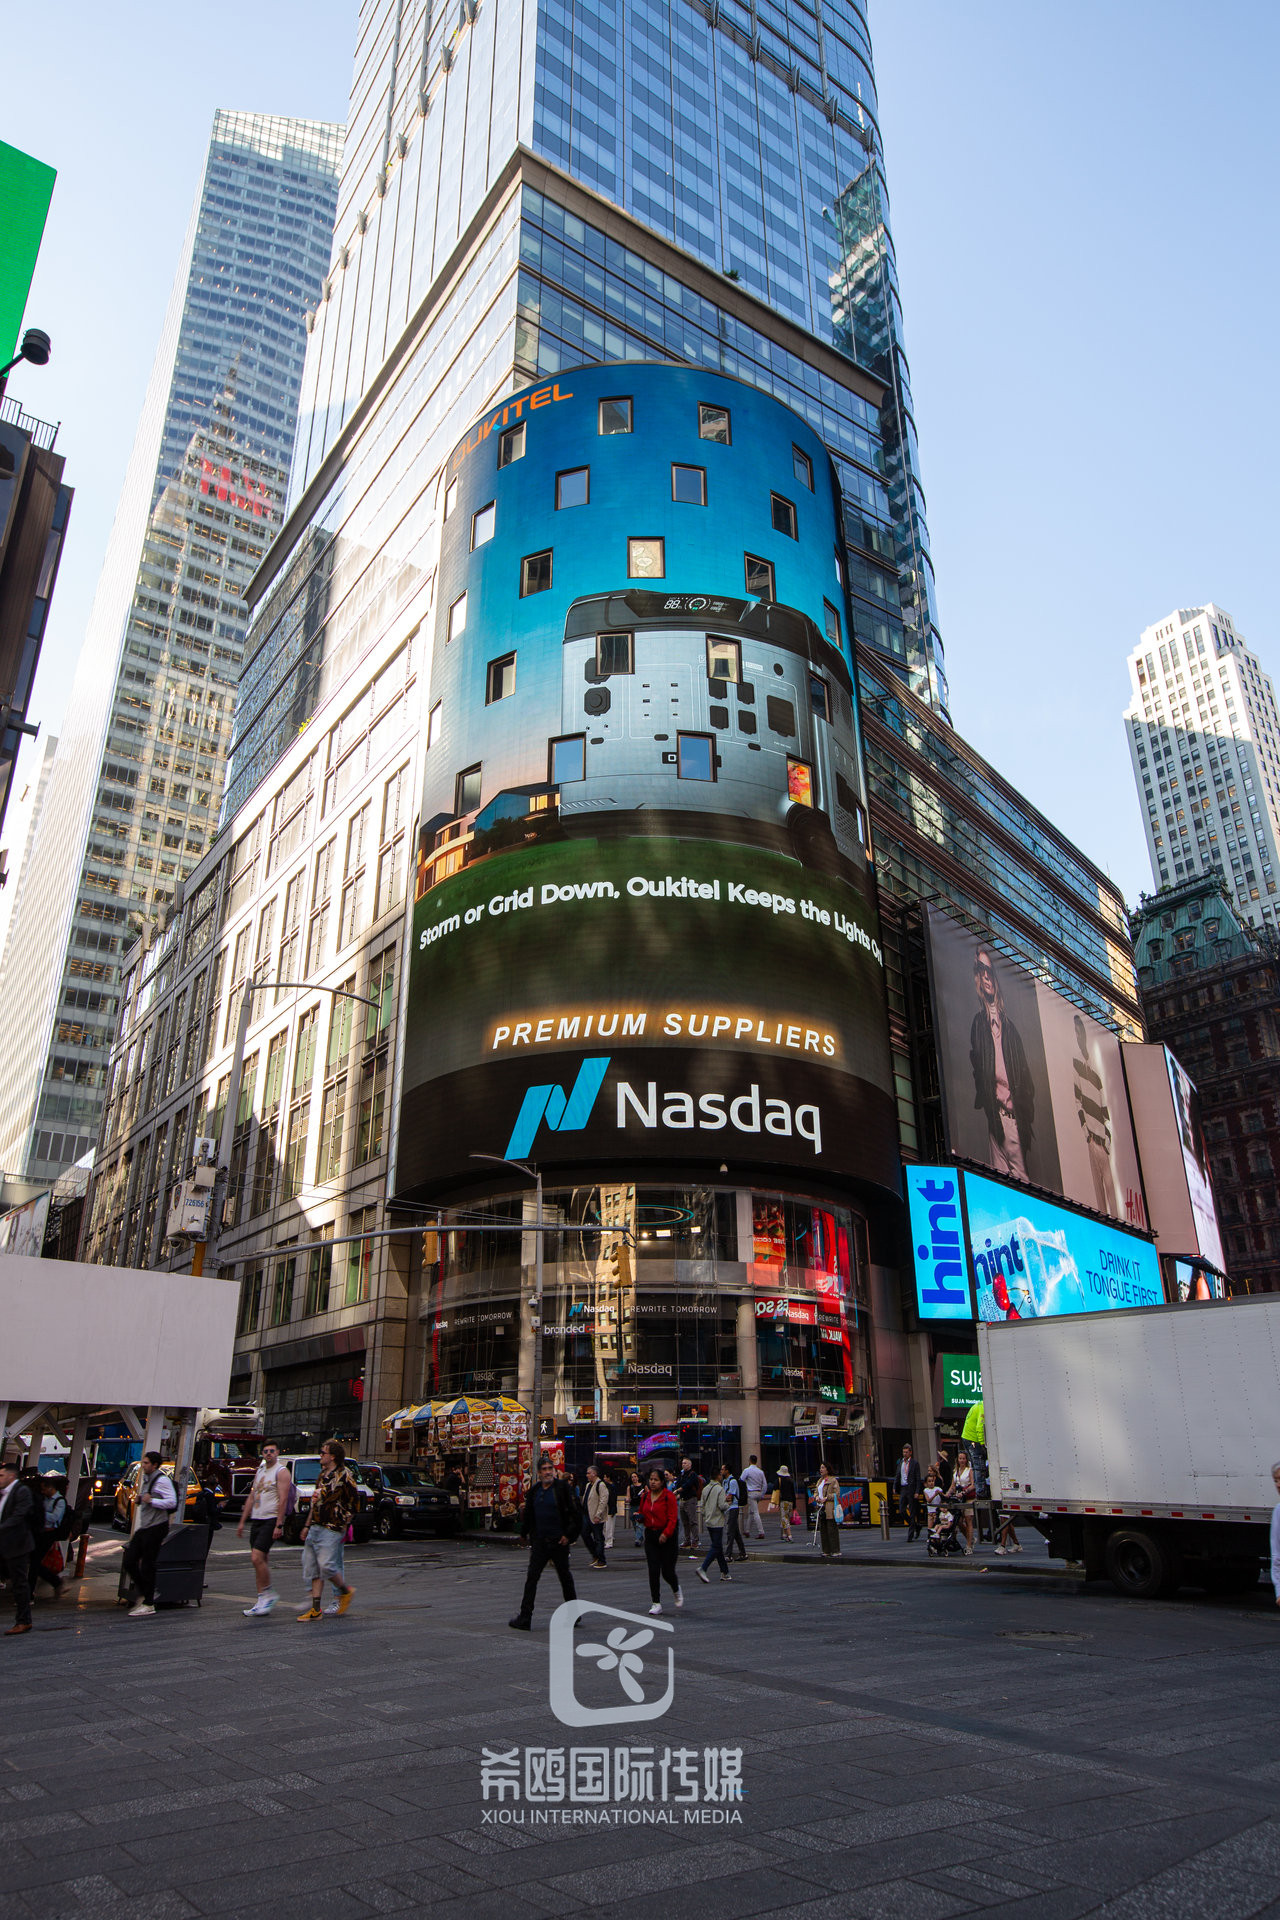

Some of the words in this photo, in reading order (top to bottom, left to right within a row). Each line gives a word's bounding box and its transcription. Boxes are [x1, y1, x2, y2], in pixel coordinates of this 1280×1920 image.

[453, 384, 574, 471] OUKITEL
[419, 914, 461, 950] Storm
[465, 905, 485, 926] or
[488, 887, 534, 916] Grid
[541, 880, 621, 904] Down,
[626, 876, 720, 900] Oukitel
[728, 882, 796, 914] Keeps
[800, 899, 831, 926] the
[834, 911, 871, 951] Lights
[492, 1013, 648, 1050] PREMIUM
[663, 1013, 836, 1057] SUPPLIERS
[616, 1081, 822, 1155] Nasdaq
[1125, 1187, 1145, 1228] H&M
[916, 1179, 966, 1305] hint
[970, 1233, 1024, 1291] hint
[1099, 1249, 1132, 1280] DRINK
[1132, 1261, 1140, 1281] IT
[1086, 1270, 1132, 1304] TONGUE
[1132, 1284, 1158, 1306] FIRST
[454, 1318, 475, 1326] REWRITE
[477, 1311, 512, 1322] TOMORROW
[583, 1305, 615, 1316] Nasdaq
[630, 1305, 667, 1313] REWRITE
[671, 1305, 718, 1314] TOMORROW
[785, 1309, 810, 1323] Nasdaq
[628, 1363, 672, 1376] Nasdaq
[783, 1367, 804, 1380] Nasdaq
